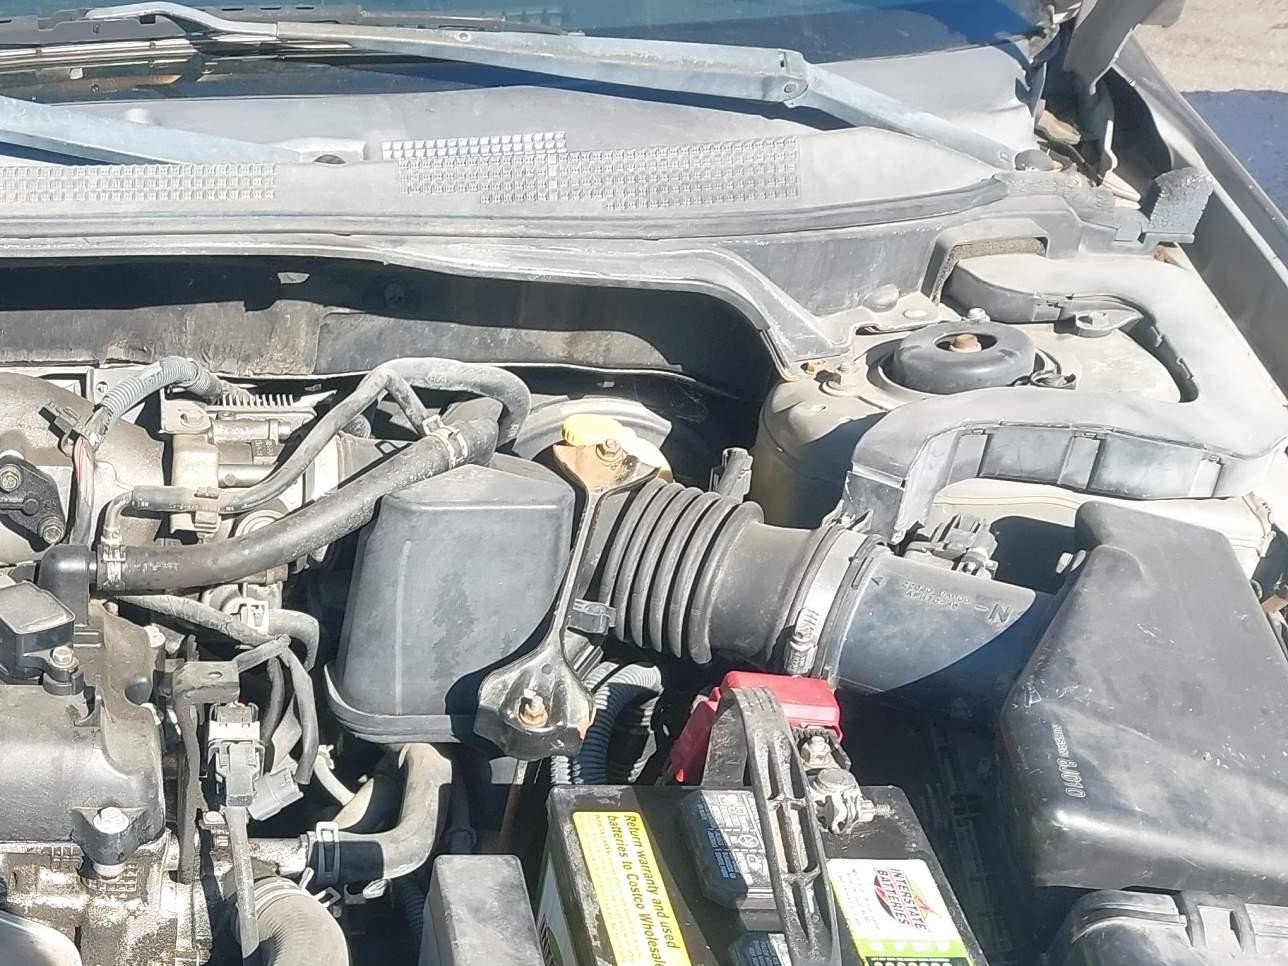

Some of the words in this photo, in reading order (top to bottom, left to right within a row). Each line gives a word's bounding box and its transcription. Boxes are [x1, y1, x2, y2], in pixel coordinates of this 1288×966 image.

[607, 814, 634, 858] batteries
[623, 814, 644, 848] Return
[622, 860, 634, 871] to
[636, 850, 661, 896] warranty
[625, 872, 646, 911] Costco
[651, 898, 670, 919] and
[876, 869, 912, 927] BATTERIES
[890, 868, 928, 931] INTERSTATE
[659, 920, 680, 949] used
